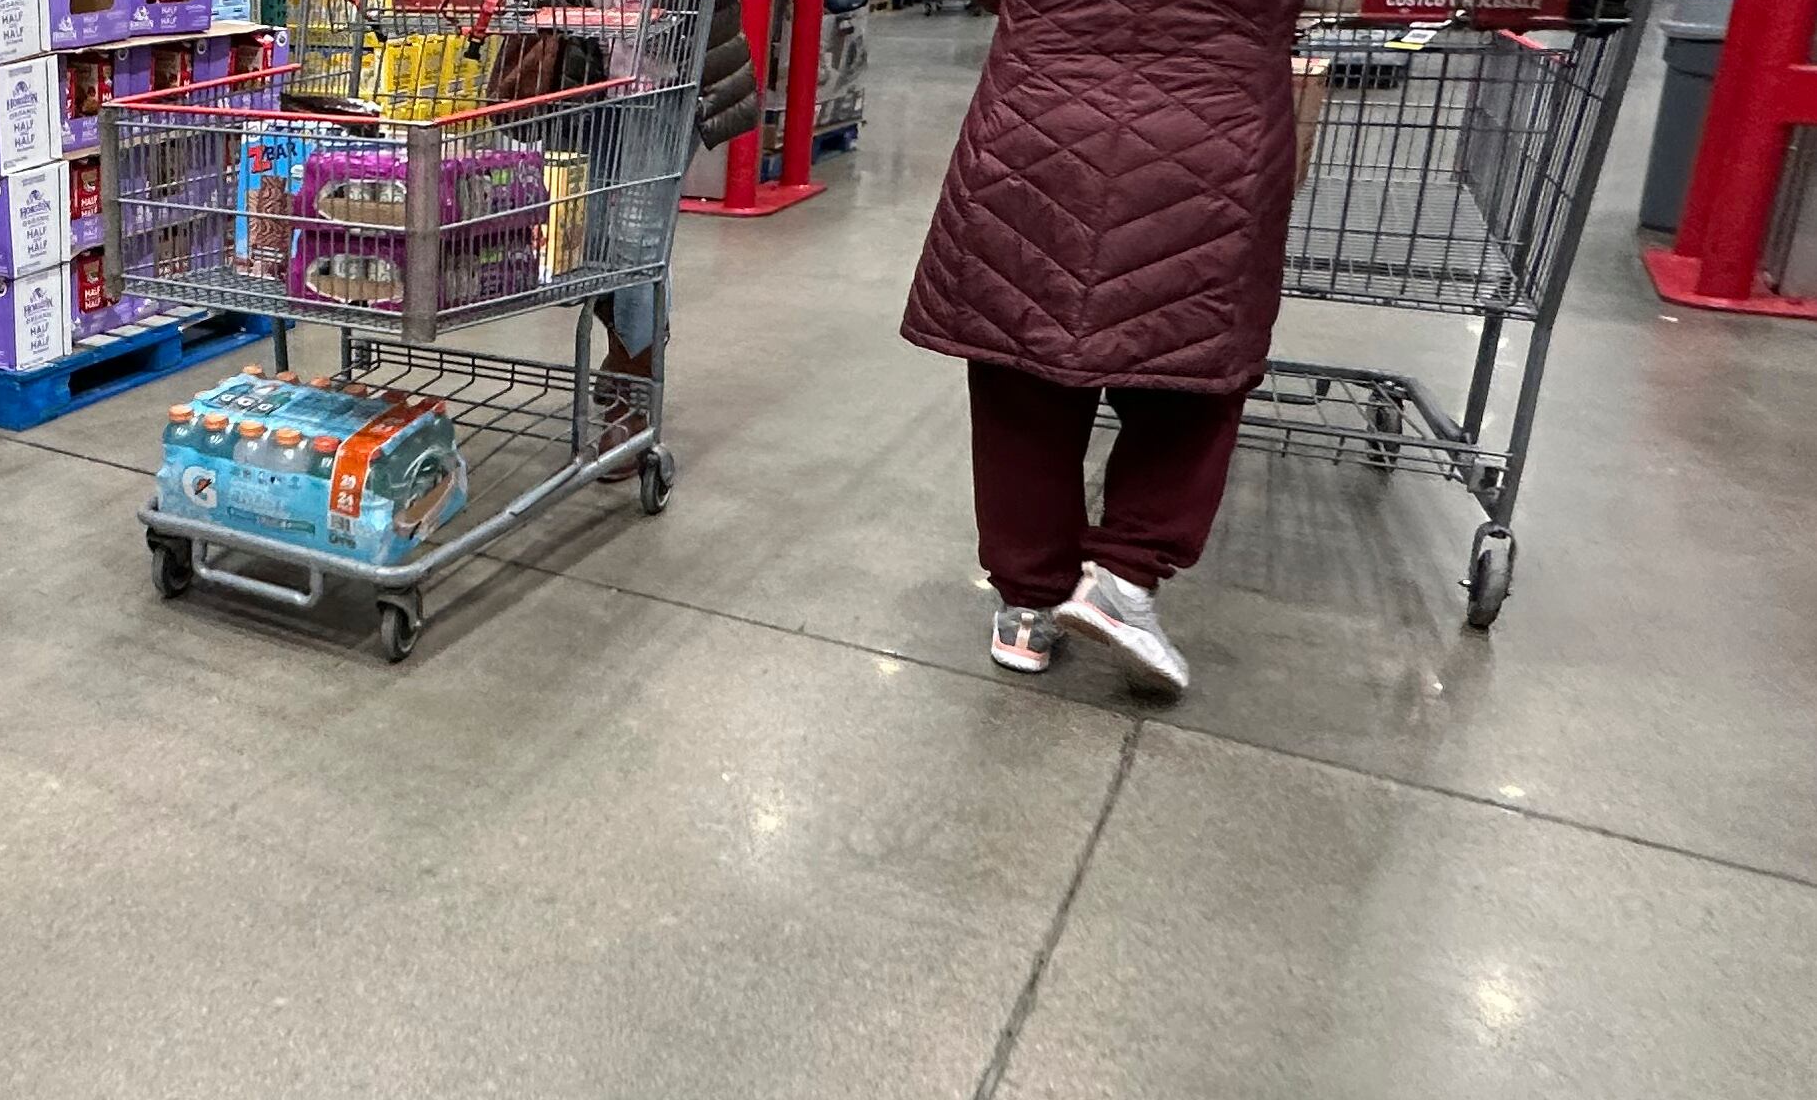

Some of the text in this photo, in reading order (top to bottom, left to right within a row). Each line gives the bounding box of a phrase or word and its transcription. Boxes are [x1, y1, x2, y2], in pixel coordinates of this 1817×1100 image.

[2, 10, 23, 24] HALF
[3, 26, 24, 40] HALF
[14, 119, 34, 132] HALF
[14, 134, 35, 148] HALF
[81, 195, 98, 207] HALF
[26, 226, 47, 239] HALF
[28, 240, 48, 253] HALF
[85, 287, 101, 298] HALF
[85, 298, 101, 309] HALF
[30, 322, 49, 336] HALF
[31, 336, 50, 351] HALF
